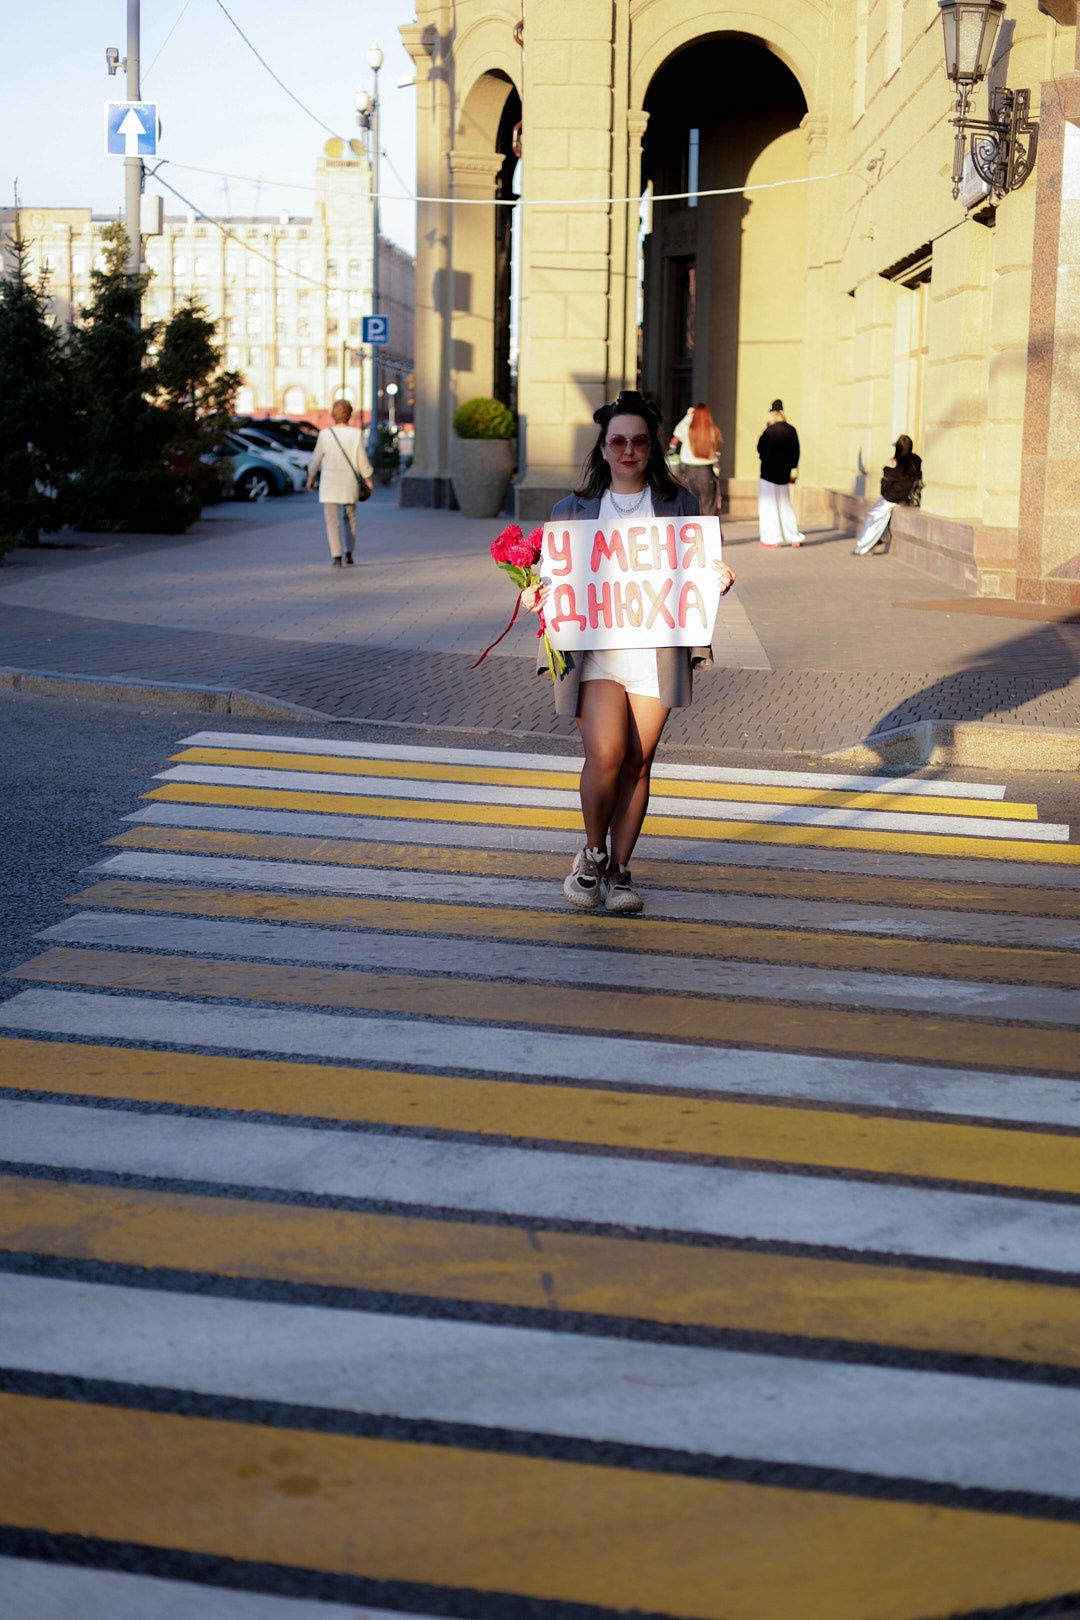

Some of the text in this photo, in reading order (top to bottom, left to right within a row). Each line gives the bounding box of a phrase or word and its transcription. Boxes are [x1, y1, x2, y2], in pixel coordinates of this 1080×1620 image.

[547, 523, 706, 576] У МЕНЯ
[550, 578, 707, 632] ДНЮХА
